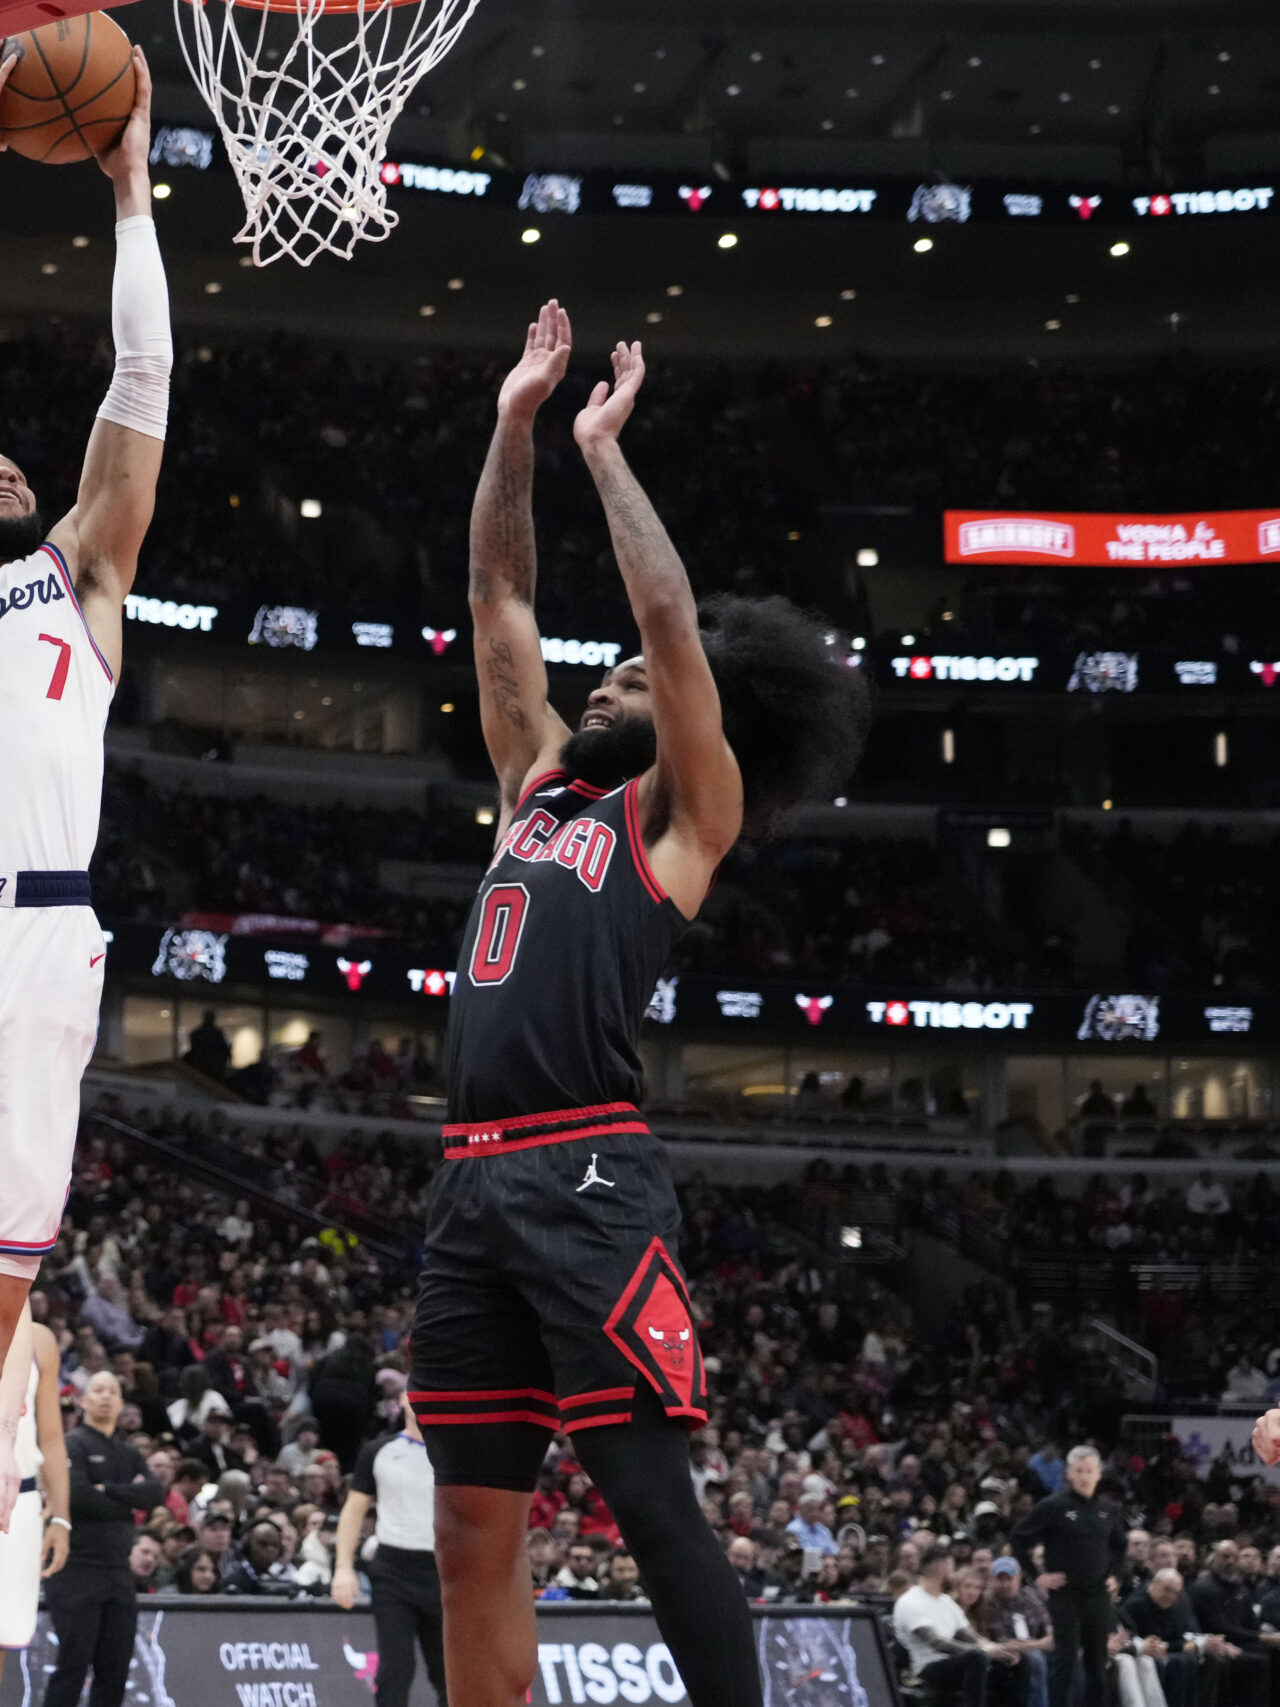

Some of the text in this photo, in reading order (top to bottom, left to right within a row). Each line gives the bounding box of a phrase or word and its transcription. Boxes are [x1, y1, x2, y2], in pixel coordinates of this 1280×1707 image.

[399, 163, 491, 196] TISSOT
[777, 188, 876, 212] TISSOT
[1170, 187, 1274, 215] TISSOT
[123, 593, 218, 632] TISSOT
[38, 633, 71, 701] 7
[931, 655, 1039, 682] TISSOT
[469, 883, 531, 986] 0
[913, 1000, 1033, 1029] TISSOT
[219, 1642, 320, 1671] OFFICIAL
[537, 1642, 688, 1704] TISSO
[235, 1681, 319, 1707] WATCH
